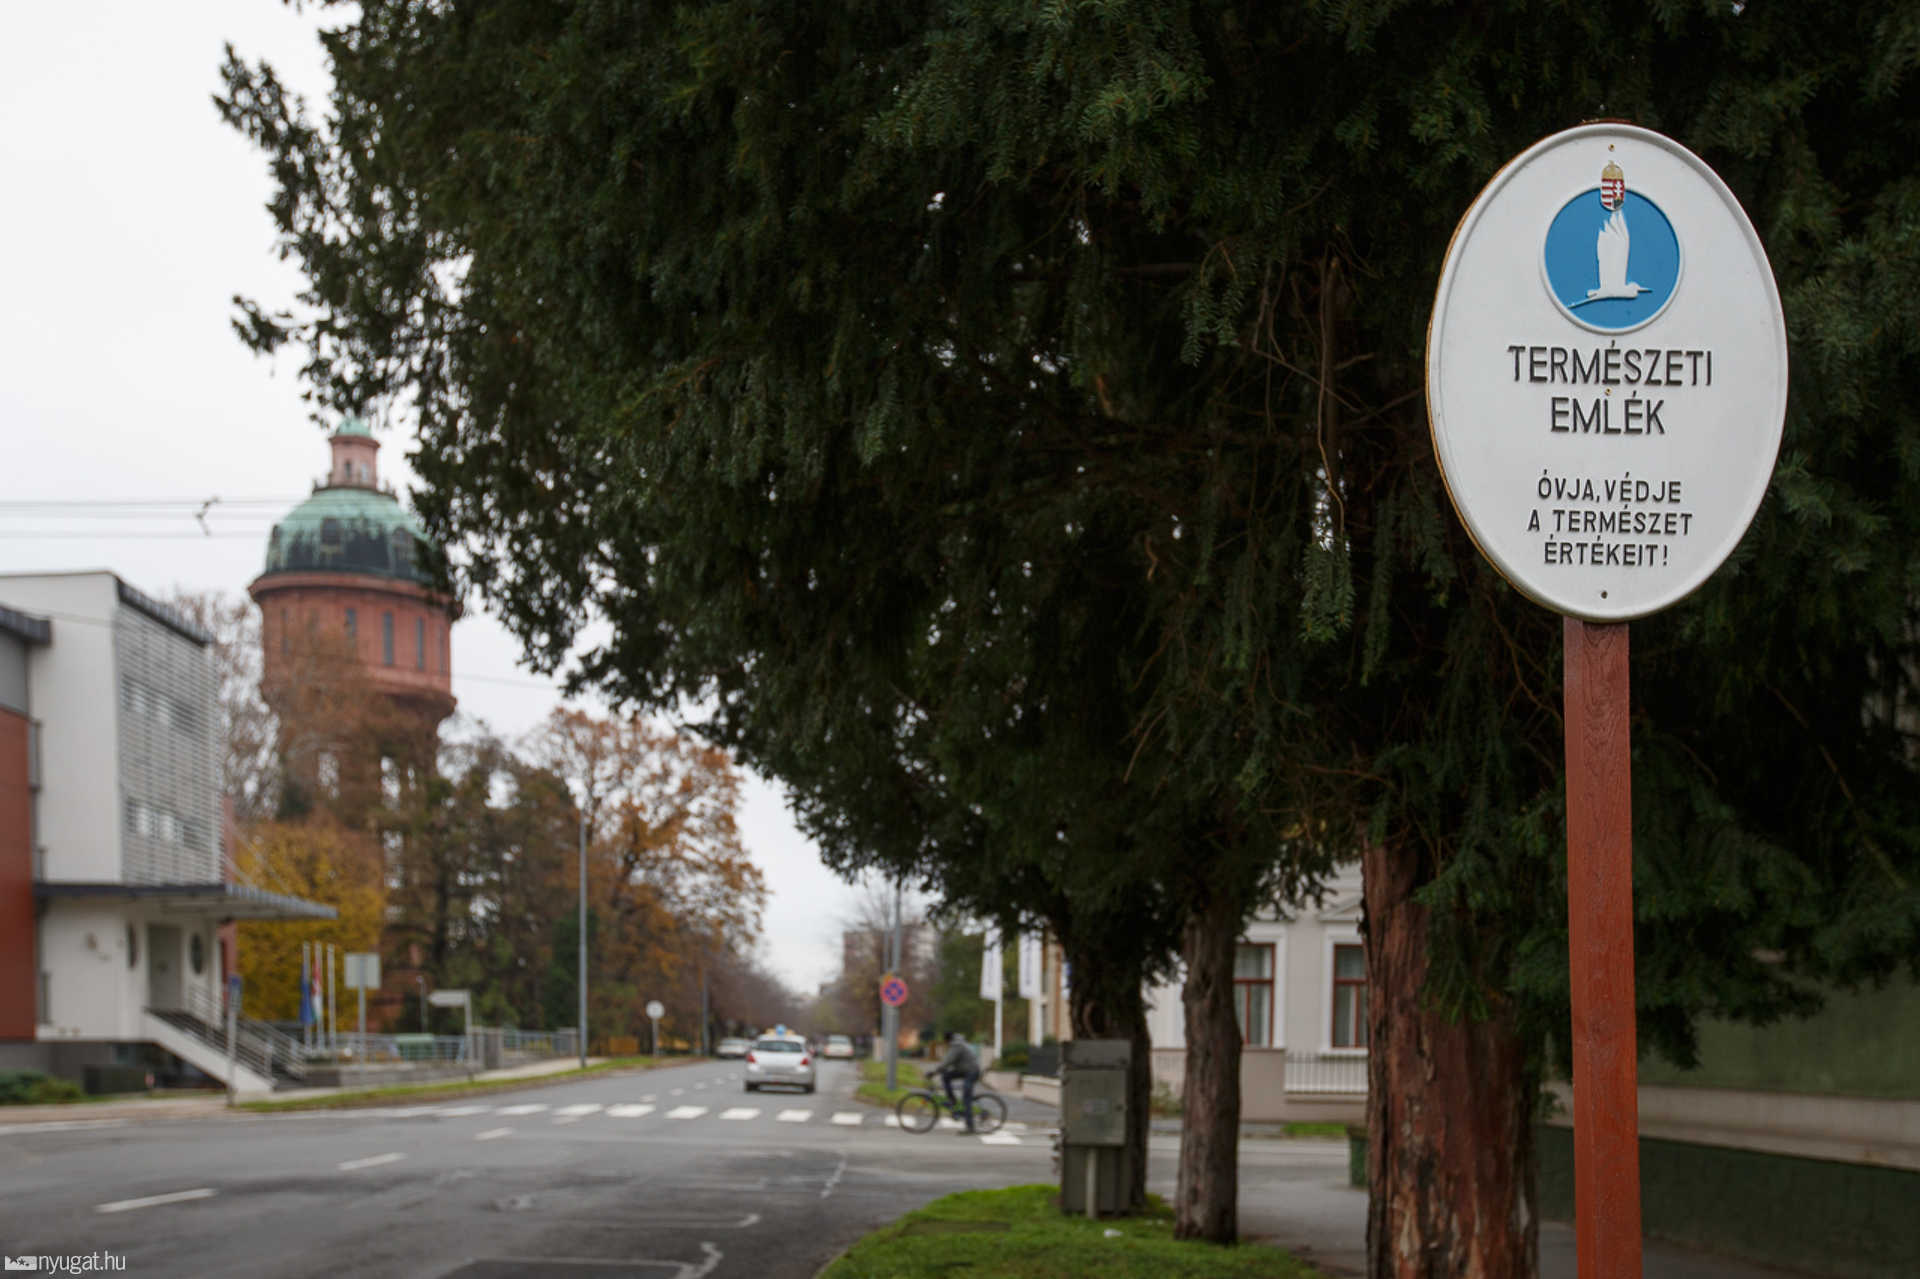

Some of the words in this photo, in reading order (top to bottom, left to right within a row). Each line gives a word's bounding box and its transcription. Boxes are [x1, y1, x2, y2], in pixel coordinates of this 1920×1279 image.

[1507, 340, 1712, 386] TERMÉSZETI
[1551, 390, 1665, 435] EMLÉK
[1527, 509, 1540, 531] A
[1553, 504, 1692, 535] TERMÉSZET
[1544, 533, 1667, 566] ÉRTÉKEIT!
